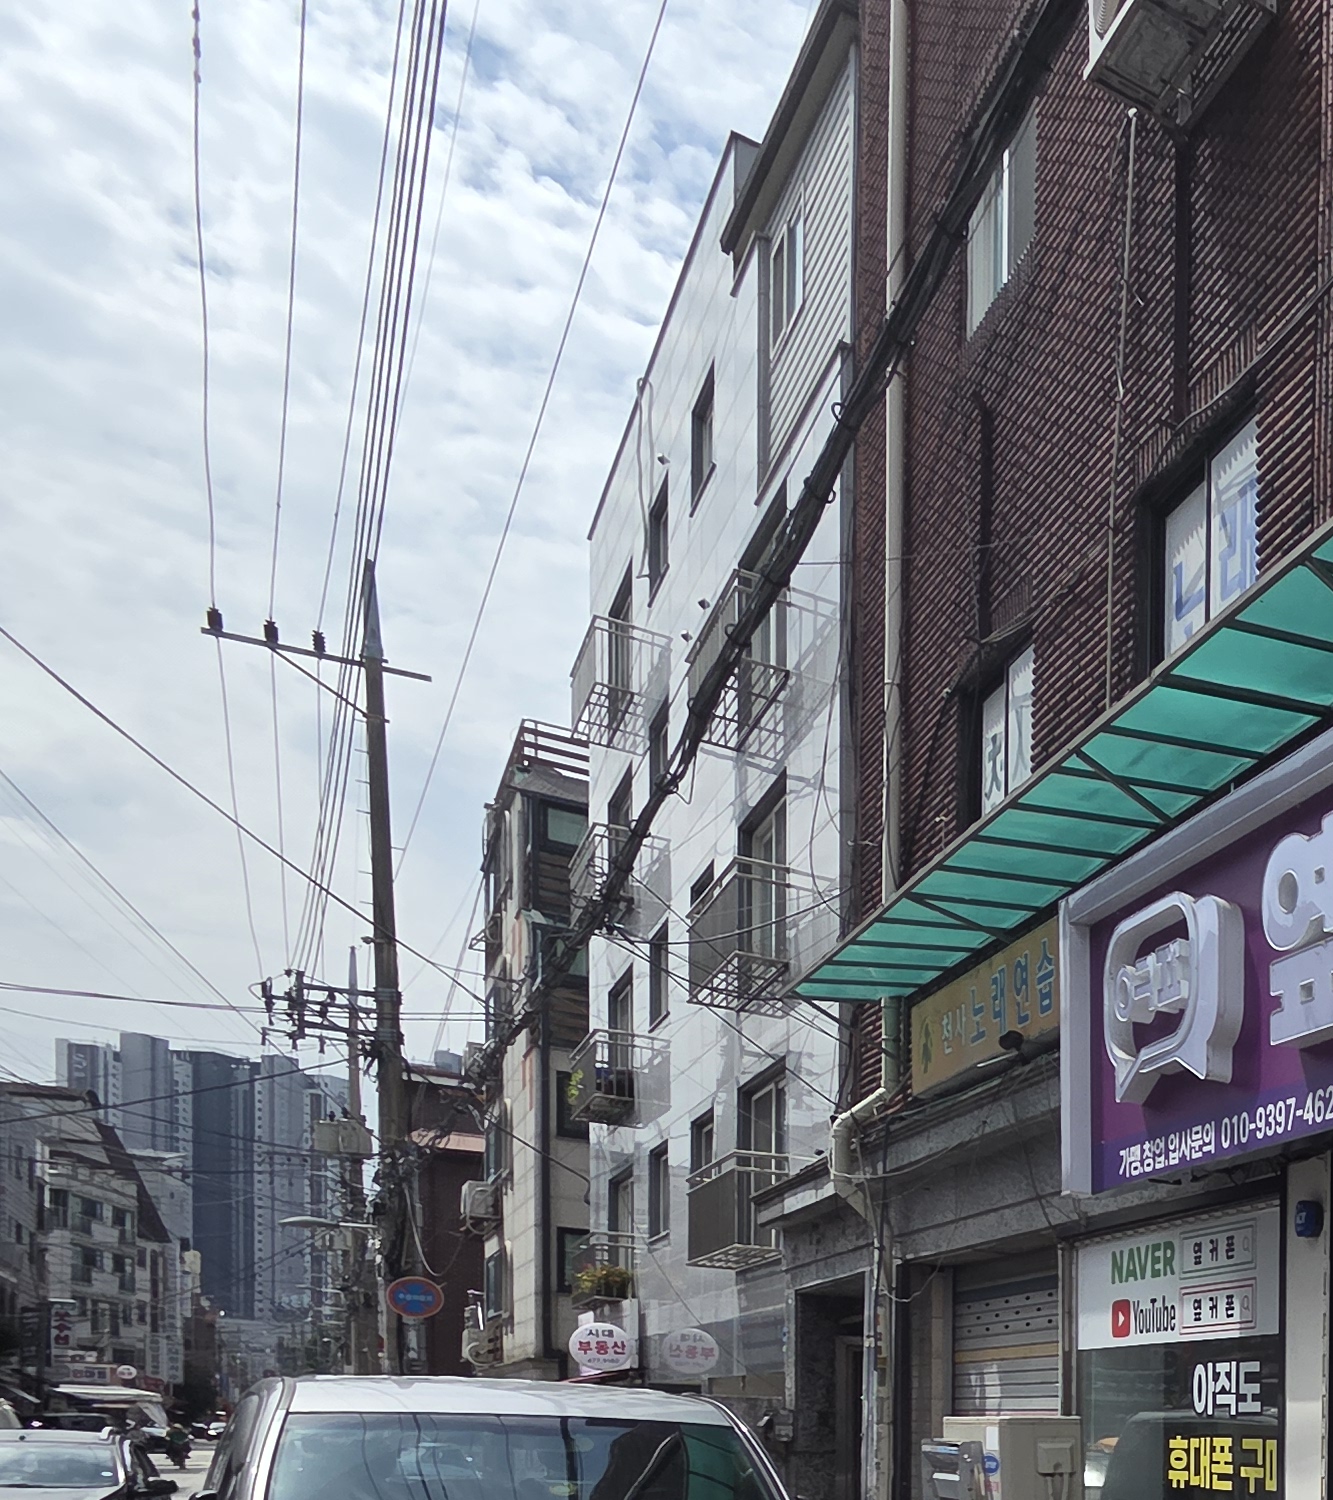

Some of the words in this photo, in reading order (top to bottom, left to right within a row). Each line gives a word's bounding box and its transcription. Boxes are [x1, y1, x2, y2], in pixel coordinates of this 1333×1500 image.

[1111, 1240, 1176, 1285] NAVER
[1132, 1295, 1176, 1335] YouTube
[577, 1340, 627, 1356] 부동산
[1192, 1361, 1262, 1416] 아직도
[1168, 1435, 1234, 1491] 휴대폰
